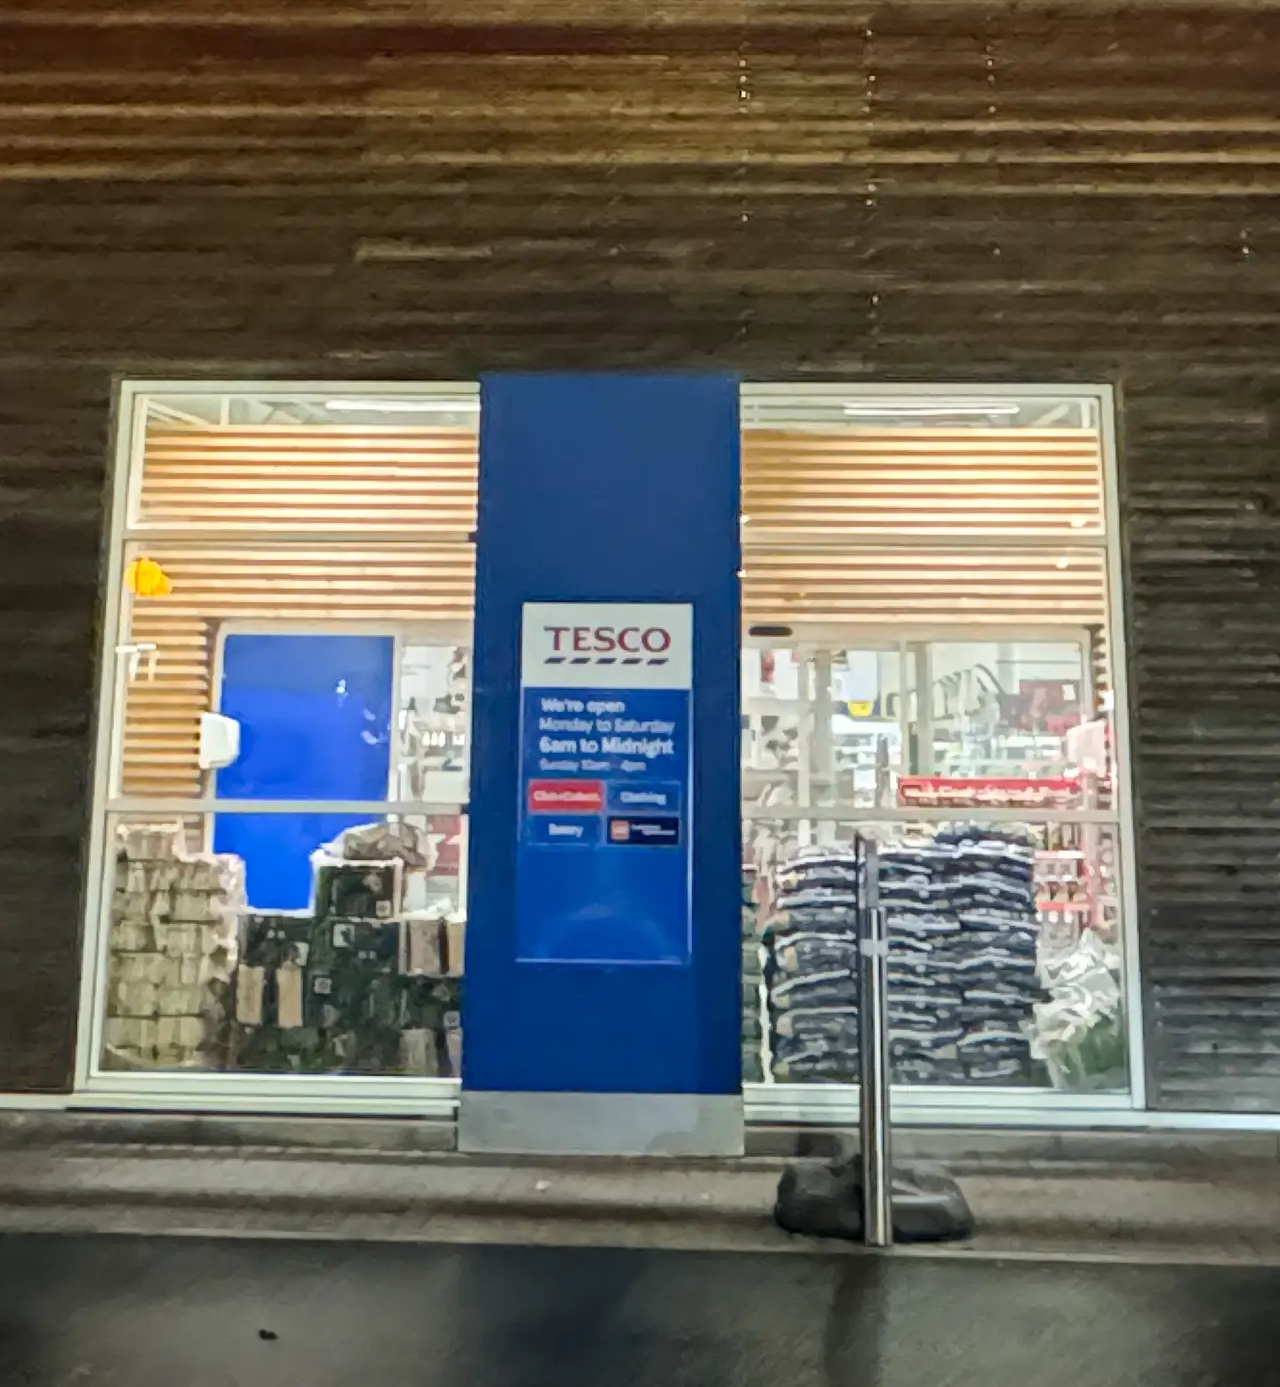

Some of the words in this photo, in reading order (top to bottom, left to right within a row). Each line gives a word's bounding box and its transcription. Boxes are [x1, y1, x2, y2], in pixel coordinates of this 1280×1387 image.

[543, 626, 671, 652] TESCO
[586, 700, 626, 716] open
[539, 717, 594, 734] Monday
[596, 719, 612, 732] to
[614, 717, 675, 735] Saturday
[579, 738, 600, 754] to
[601, 736, 675, 758] Midnight
